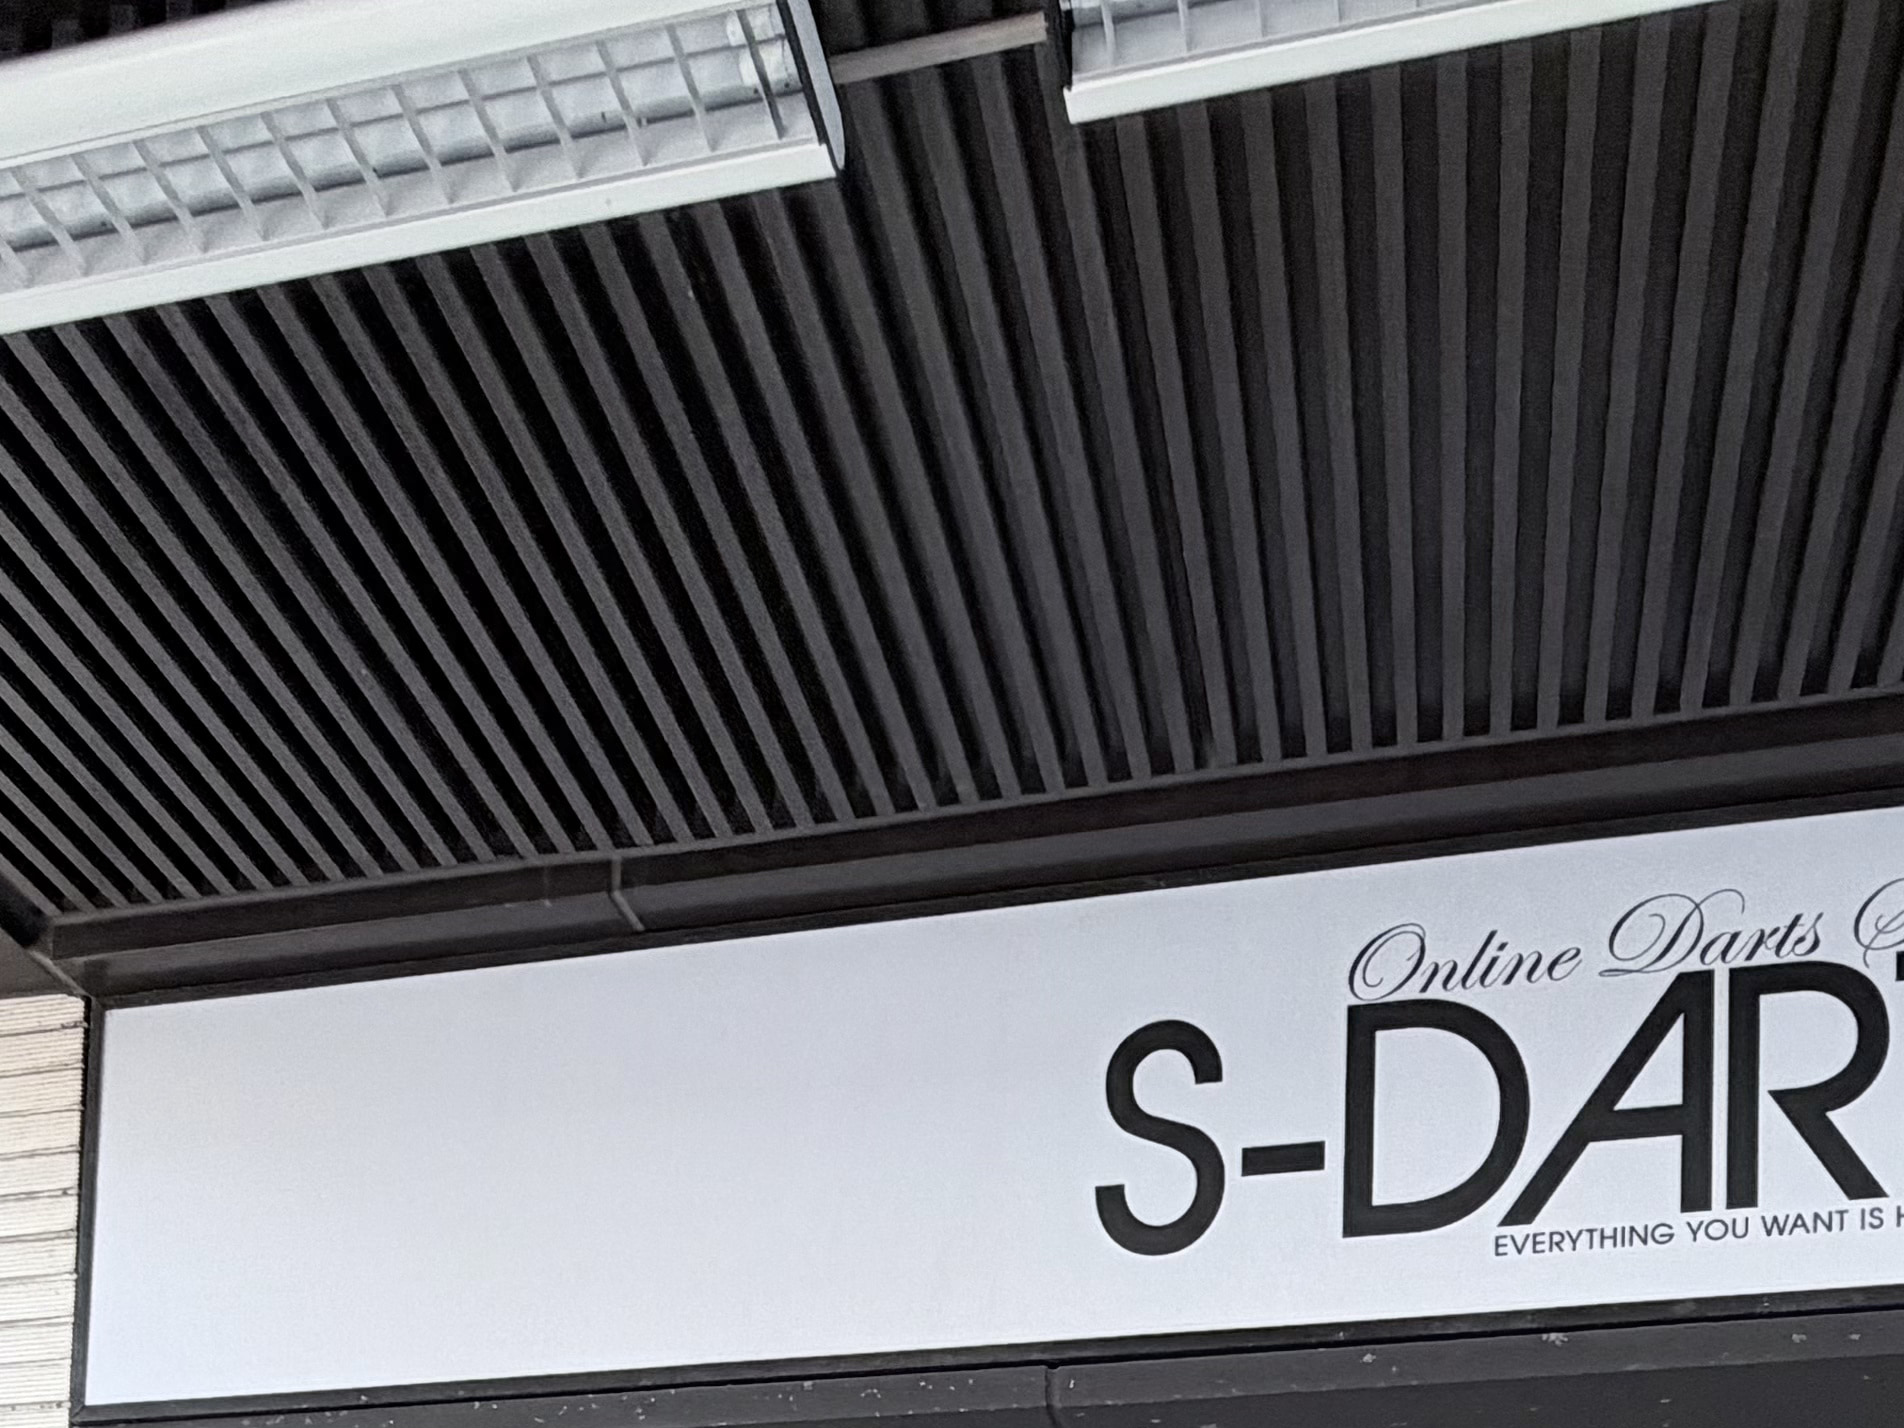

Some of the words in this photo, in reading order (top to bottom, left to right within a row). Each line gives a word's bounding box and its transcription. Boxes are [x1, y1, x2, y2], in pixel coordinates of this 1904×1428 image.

[1349, 921, 1583, 1001] Online
[1599, 893, 1824, 978] Darts
[1493, 1221, 1675, 1257] EVERYTHING
[1685, 1217, 1752, 1244] YOU
[1759, 1211, 1853, 1239] WANT
[1859, 1206, 1885, 1231] IS
